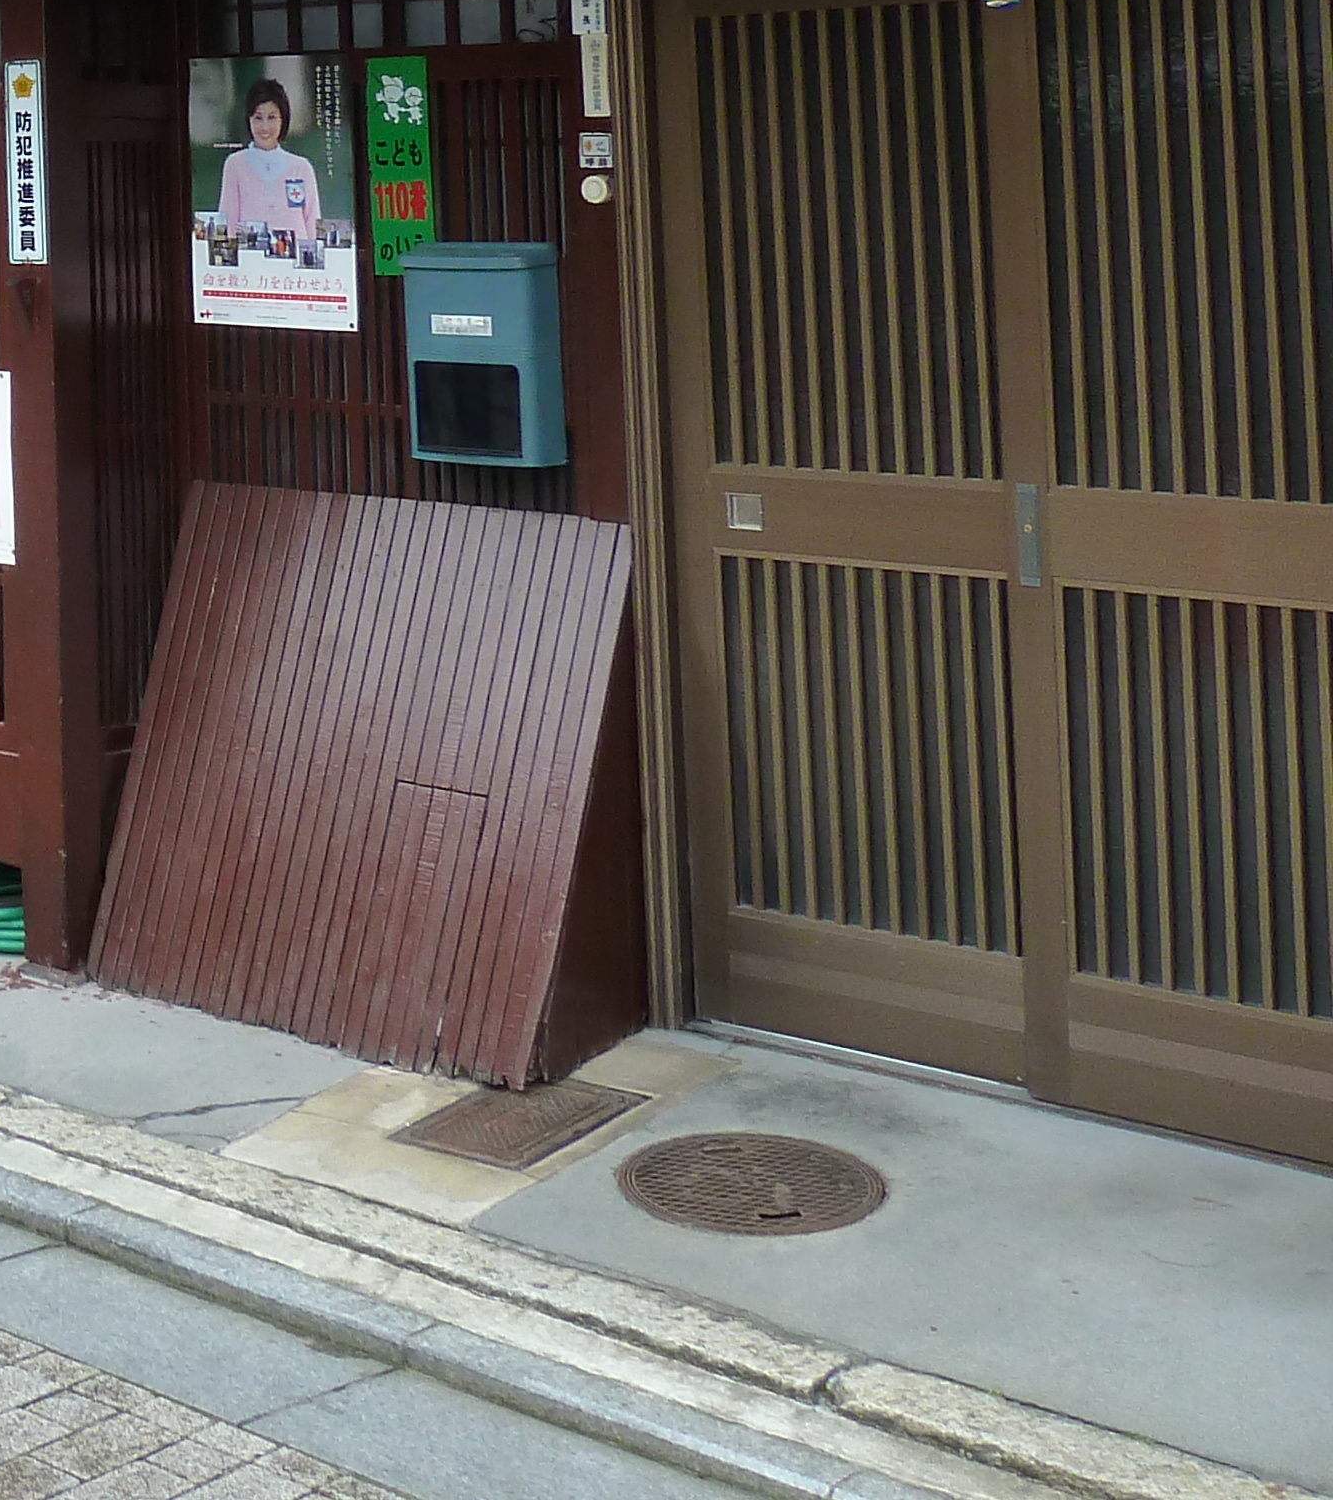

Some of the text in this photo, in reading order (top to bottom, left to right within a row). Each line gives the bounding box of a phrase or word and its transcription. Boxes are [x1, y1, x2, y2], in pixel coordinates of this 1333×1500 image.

[375, 138, 423, 167] こども
[15, 111, 36, 252] 防犯推進委員
[374, 180, 428, 221] 110番
